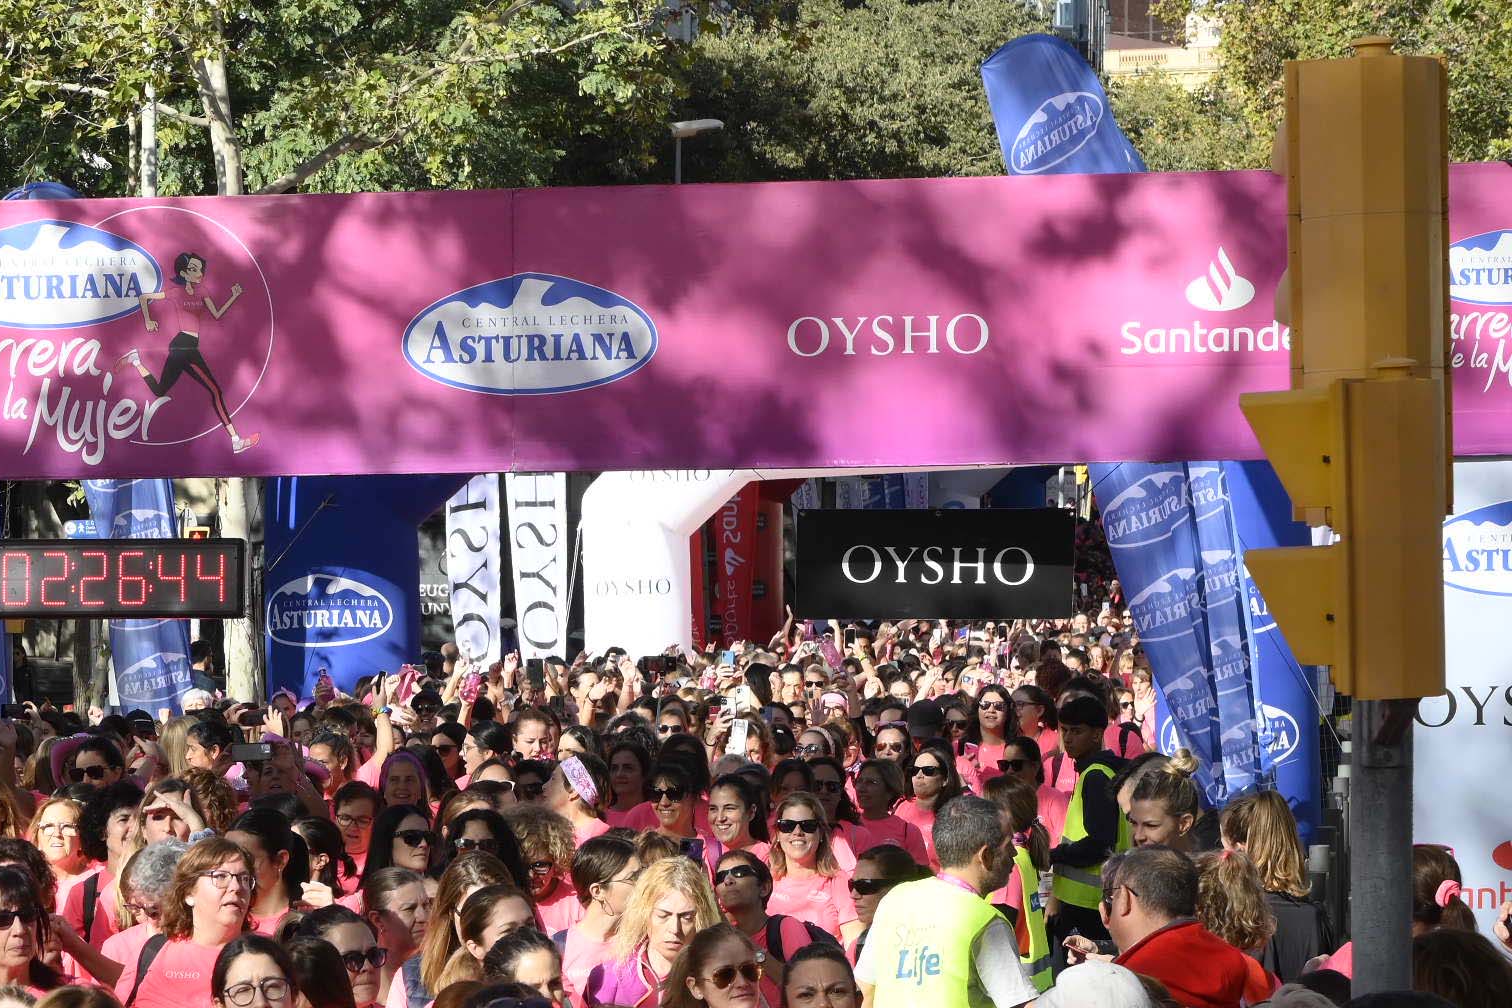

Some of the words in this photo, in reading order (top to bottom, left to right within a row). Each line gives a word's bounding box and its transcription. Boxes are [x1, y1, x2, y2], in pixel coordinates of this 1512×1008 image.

[423, 319, 638, 364] ASTURIANA
[461, 315, 540, 328] CENTRAL
[549, 313, 629, 326] LECHERA
[787, 312, 990, 358] OYSHO
[2, 380, 29, 421] la
[22, 371, 173, 466] Mujer
[1, 551, 225, 606] 02:26:44
[842, 544, 1035, 586] OYSHO
[271, 603, 384, 632] ASTURIANA
[283, 600, 325, 608] CENTRAL
[330, 599, 379, 607] LECHERA
[165, 969, 201, 979] OYSHO
[895, 945, 942, 987] Life
